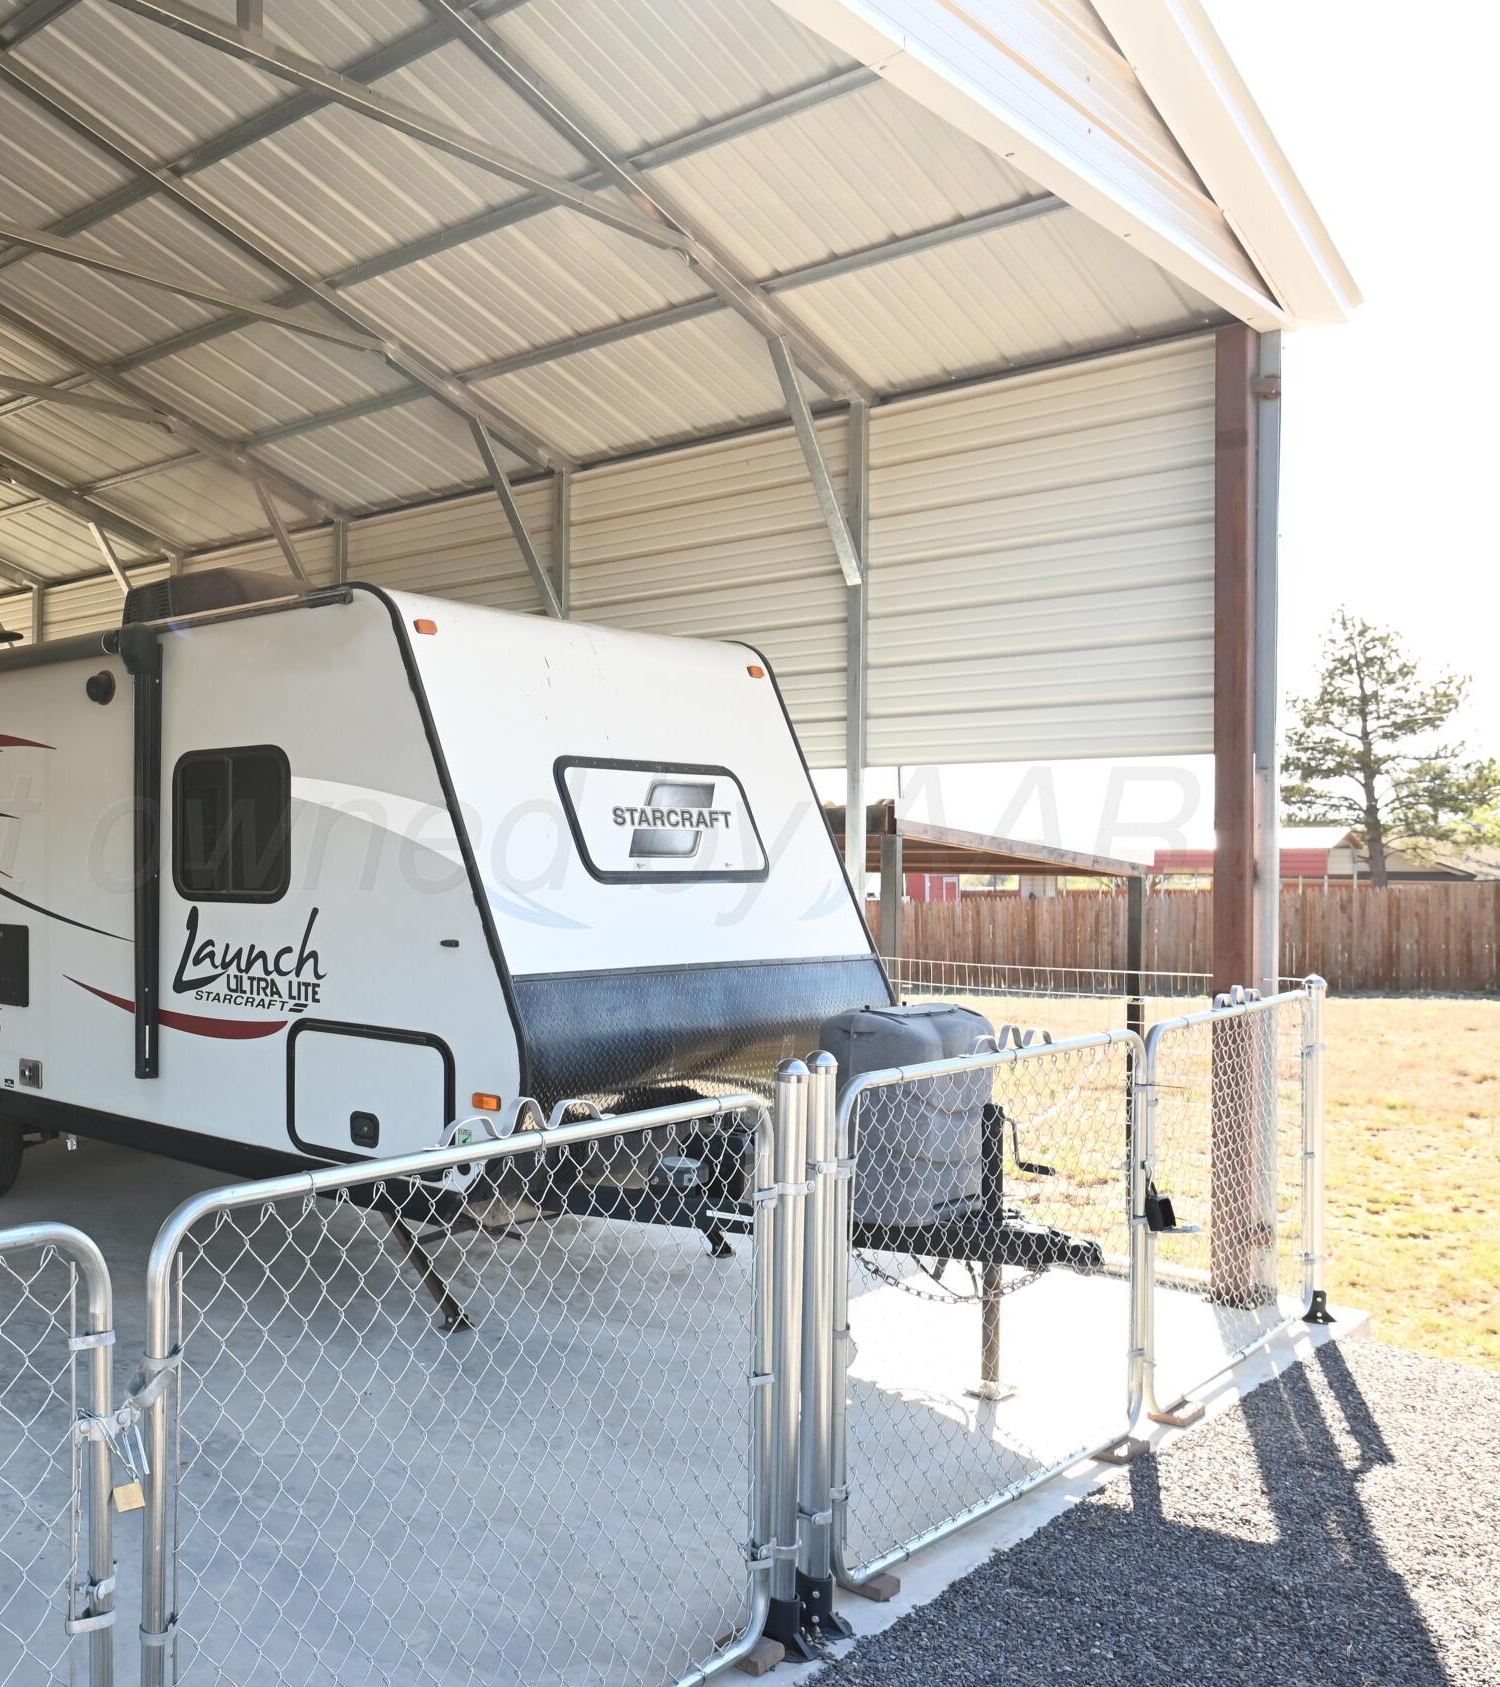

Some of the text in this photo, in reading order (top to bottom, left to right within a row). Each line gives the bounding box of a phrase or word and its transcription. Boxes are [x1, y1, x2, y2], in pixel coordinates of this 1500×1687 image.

[612, 805, 732, 829] STARCRAFT
[173, 905, 328, 993] Launch
[194, 990, 289, 1012] STARCRAFT
[226, 974, 321, 1004] ULTRA LITE
